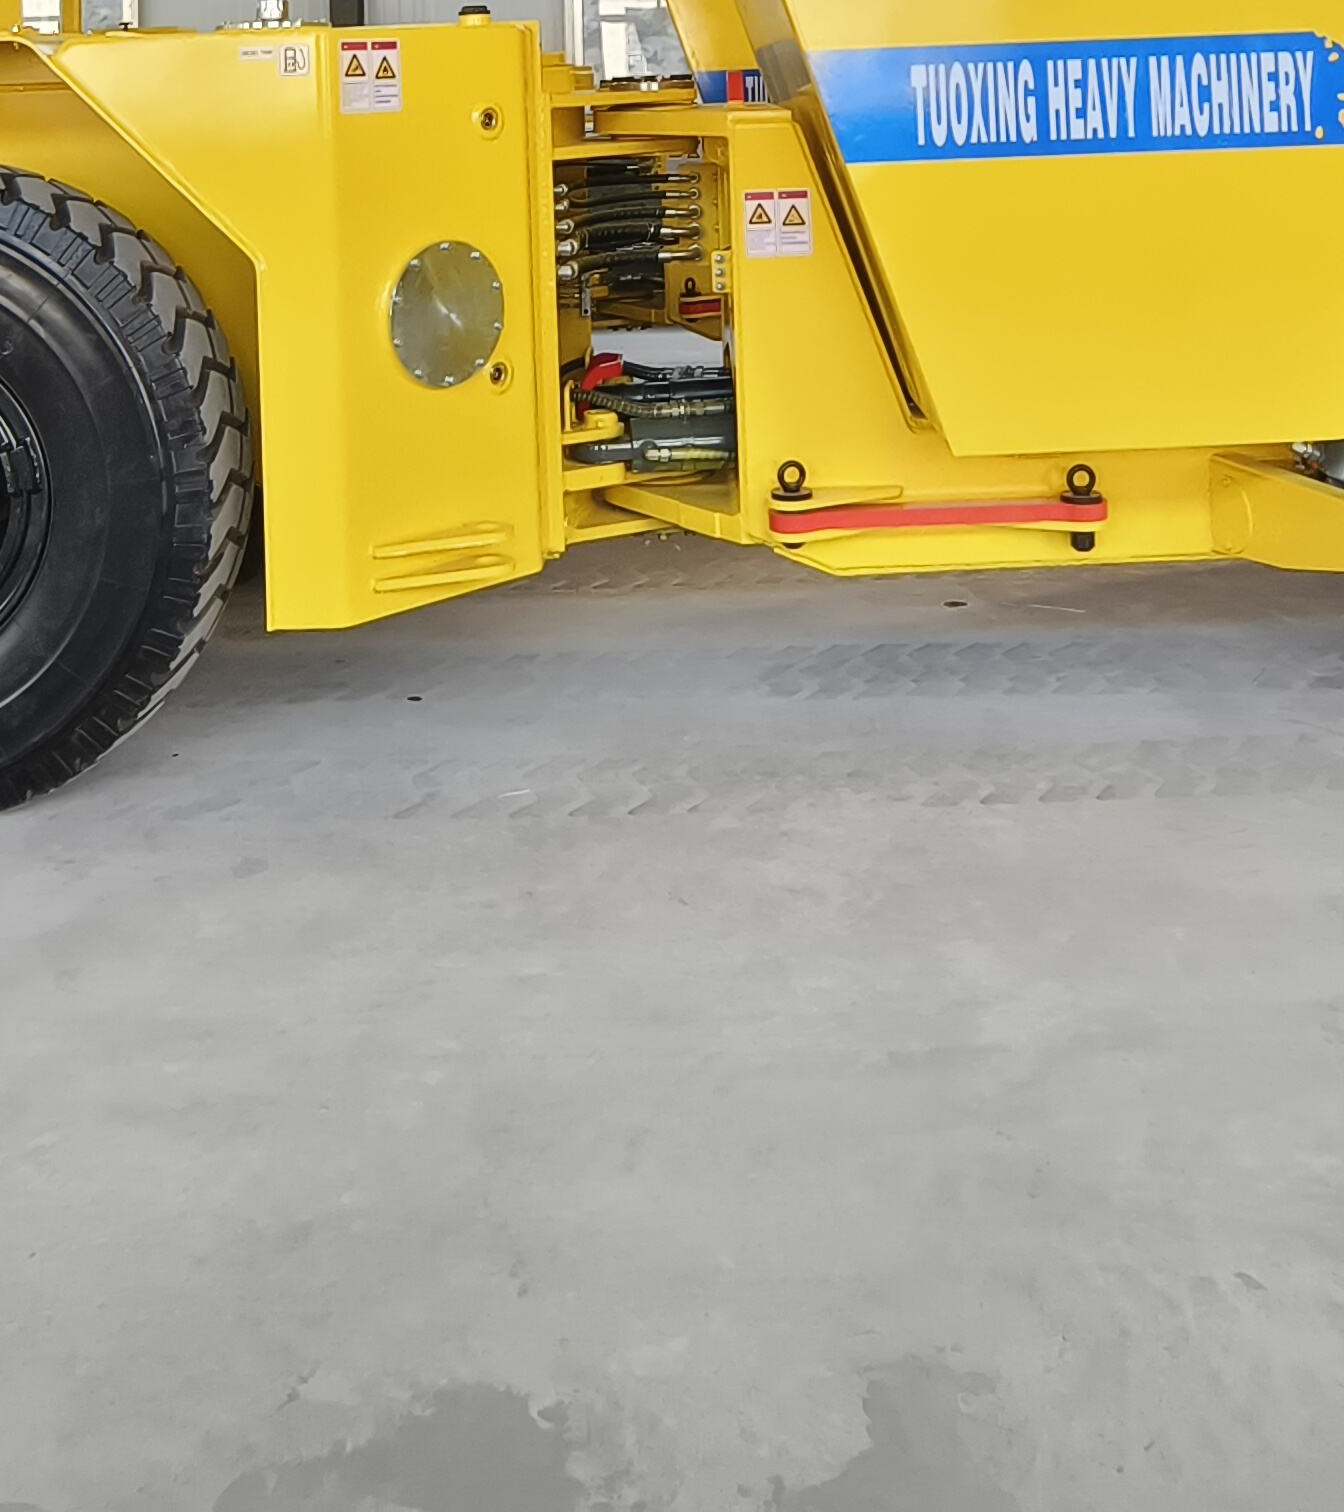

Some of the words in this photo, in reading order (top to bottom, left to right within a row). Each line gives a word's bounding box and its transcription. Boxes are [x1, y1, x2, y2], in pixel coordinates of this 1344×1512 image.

[910, 58, 1038, 147] TUOXING
[1046, 56, 1137, 141] HEAVY
[1148, 50, 1314, 137] MACHINERY
